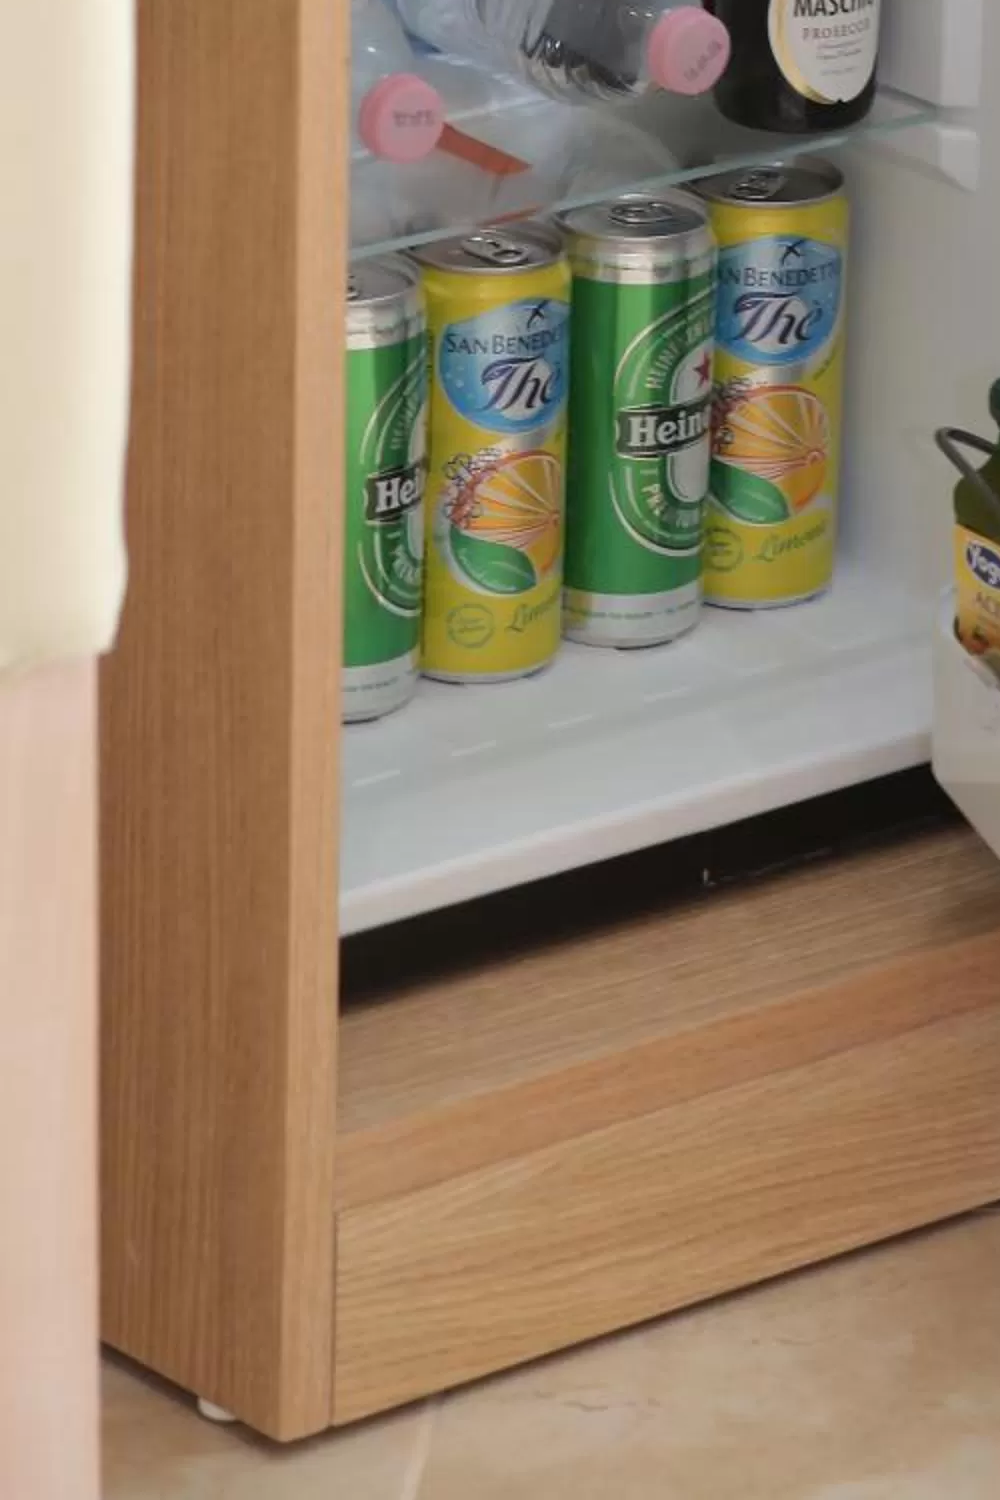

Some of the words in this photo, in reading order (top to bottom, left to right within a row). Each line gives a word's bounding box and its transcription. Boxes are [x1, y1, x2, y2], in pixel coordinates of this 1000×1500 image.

[732, 291, 823, 345] Thè
[446, 332, 488, 355] SAN
[375, 472, 424, 514] Hei
